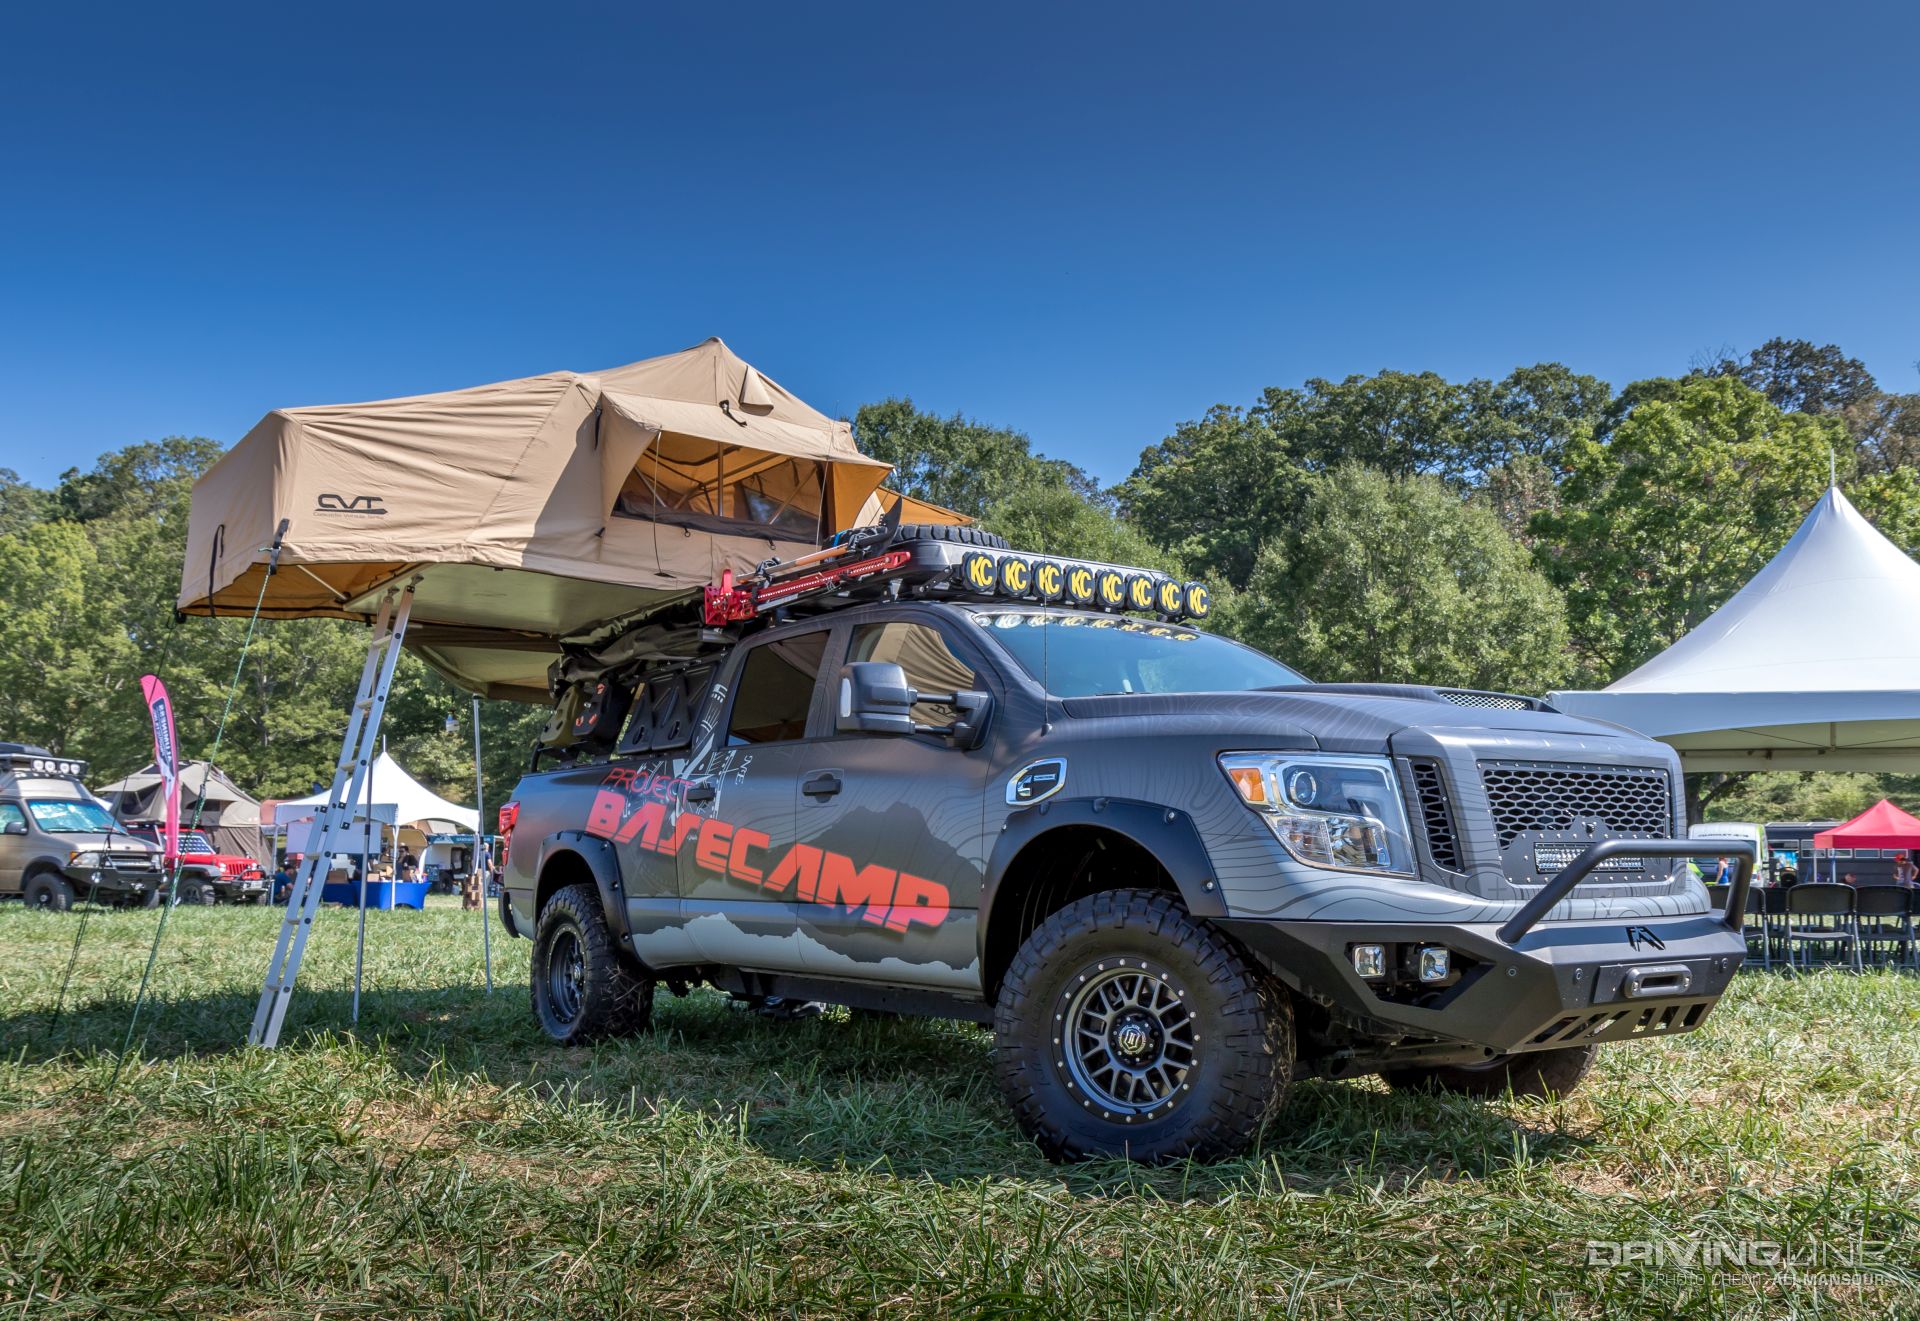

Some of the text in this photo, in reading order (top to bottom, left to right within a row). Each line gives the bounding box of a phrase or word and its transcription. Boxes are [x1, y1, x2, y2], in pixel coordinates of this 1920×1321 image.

[317, 493, 384, 510] CVT
[970, 556, 993, 587] KC
[1005, 560, 1027, 591] KC
[1038, 565, 1060, 595] KC
[1071, 569, 1092, 599] KC
[1102, 573, 1123, 603] KC
[1132, 577, 1152, 607] KC
[1161, 582, 1180, 611] KC
[1189, 586, 1208, 615] KC
[602, 767, 697, 808] PROJECT
[585, 789, 950, 933] BASECAMP
